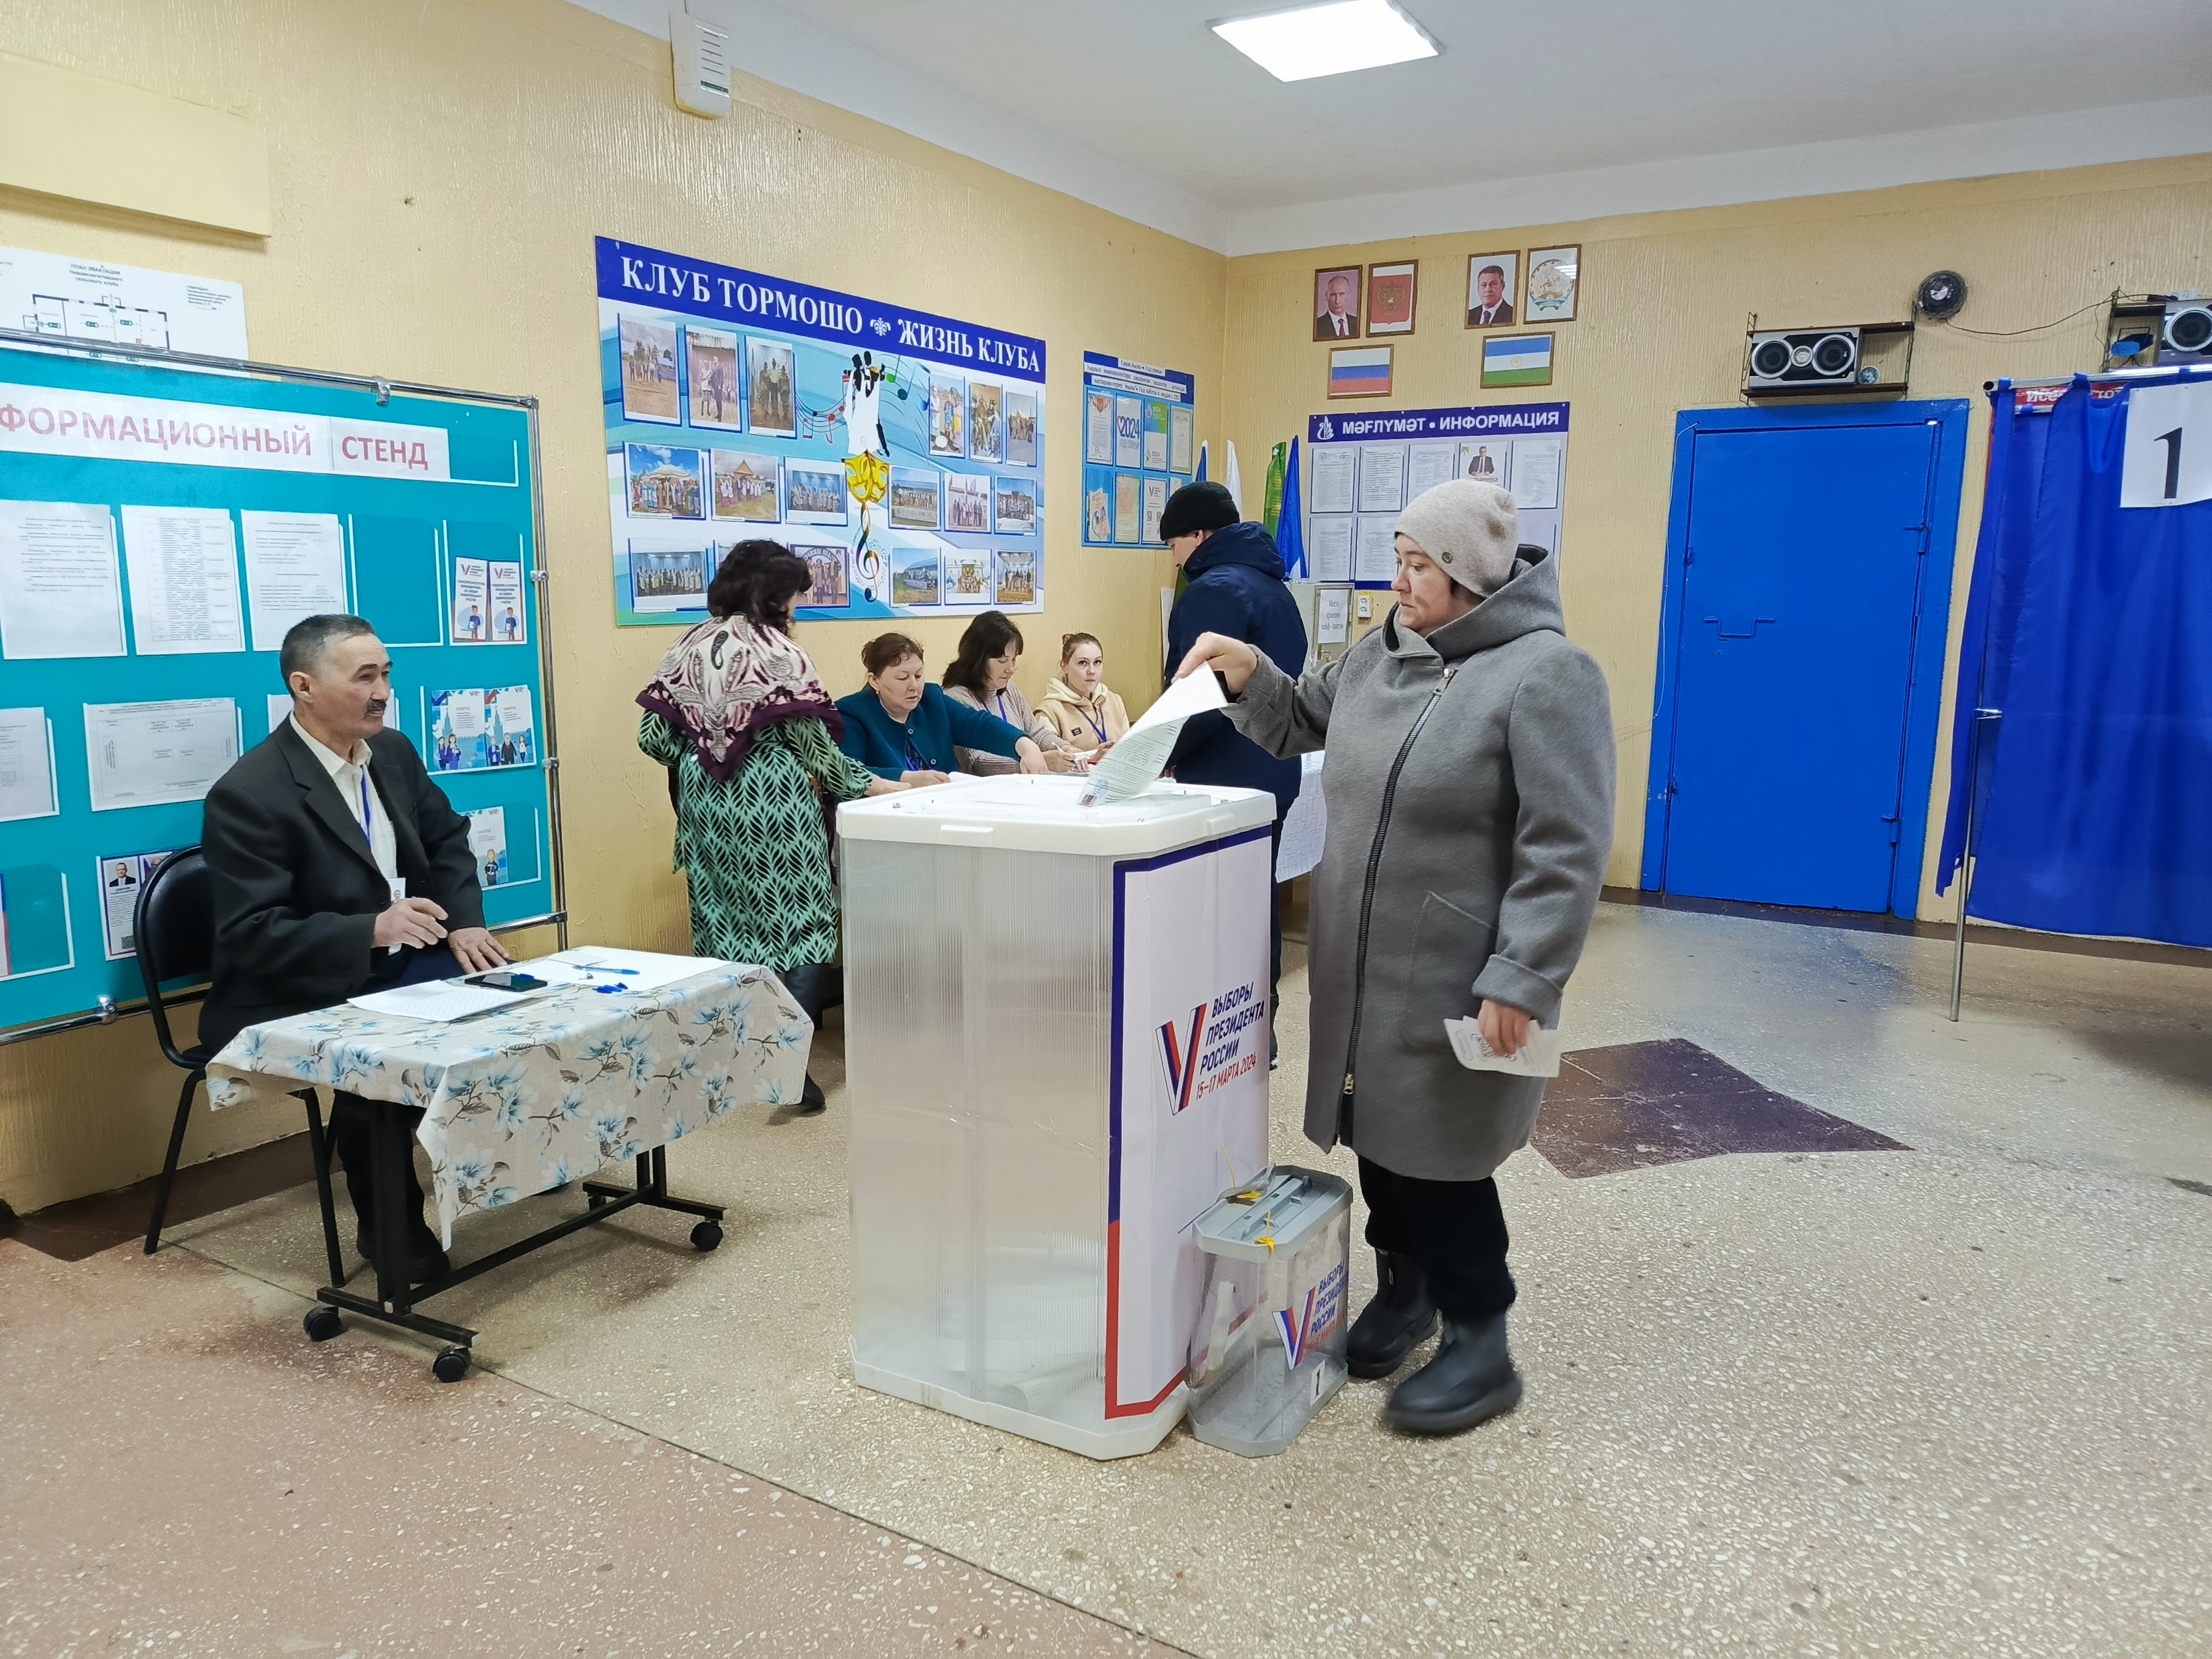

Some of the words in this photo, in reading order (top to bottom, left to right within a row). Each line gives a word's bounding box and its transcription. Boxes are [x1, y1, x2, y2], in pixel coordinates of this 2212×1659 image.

[621, 256, 710, 302] КЛУБ
[717, 278, 863, 334] ТОРМОШО
[898, 319, 973, 357] ЖИЗНЬ
[977, 337, 1040, 372] КЛУБА
[0, 404, 312, 456] ФОРМАЦИОННЫЙ
[342, 436, 428, 470] СТЕНД
[1119, 416, 1140, 440] 2024
[1439, 411, 1560, 430] ИНФОРМАЦИЯ
[2153, 427, 2182, 499] 1
[1211, 981, 1254, 1018] ВЫБОРЫ
[1205, 1000, 1265, 1047] ПРЕЗИДЕНТА
[1200, 1037, 1240, 1075] РОССИИ
[1216, 1061, 1239, 1089] МАРТА
[1240, 1051, 1257, 1076] 2024
[1318, 1258, 1345, 1295] ВЫБОРЫ
[1311, 1301, 1337, 1337] РОССИИ
[1313, 1369, 1320, 1400] 1
